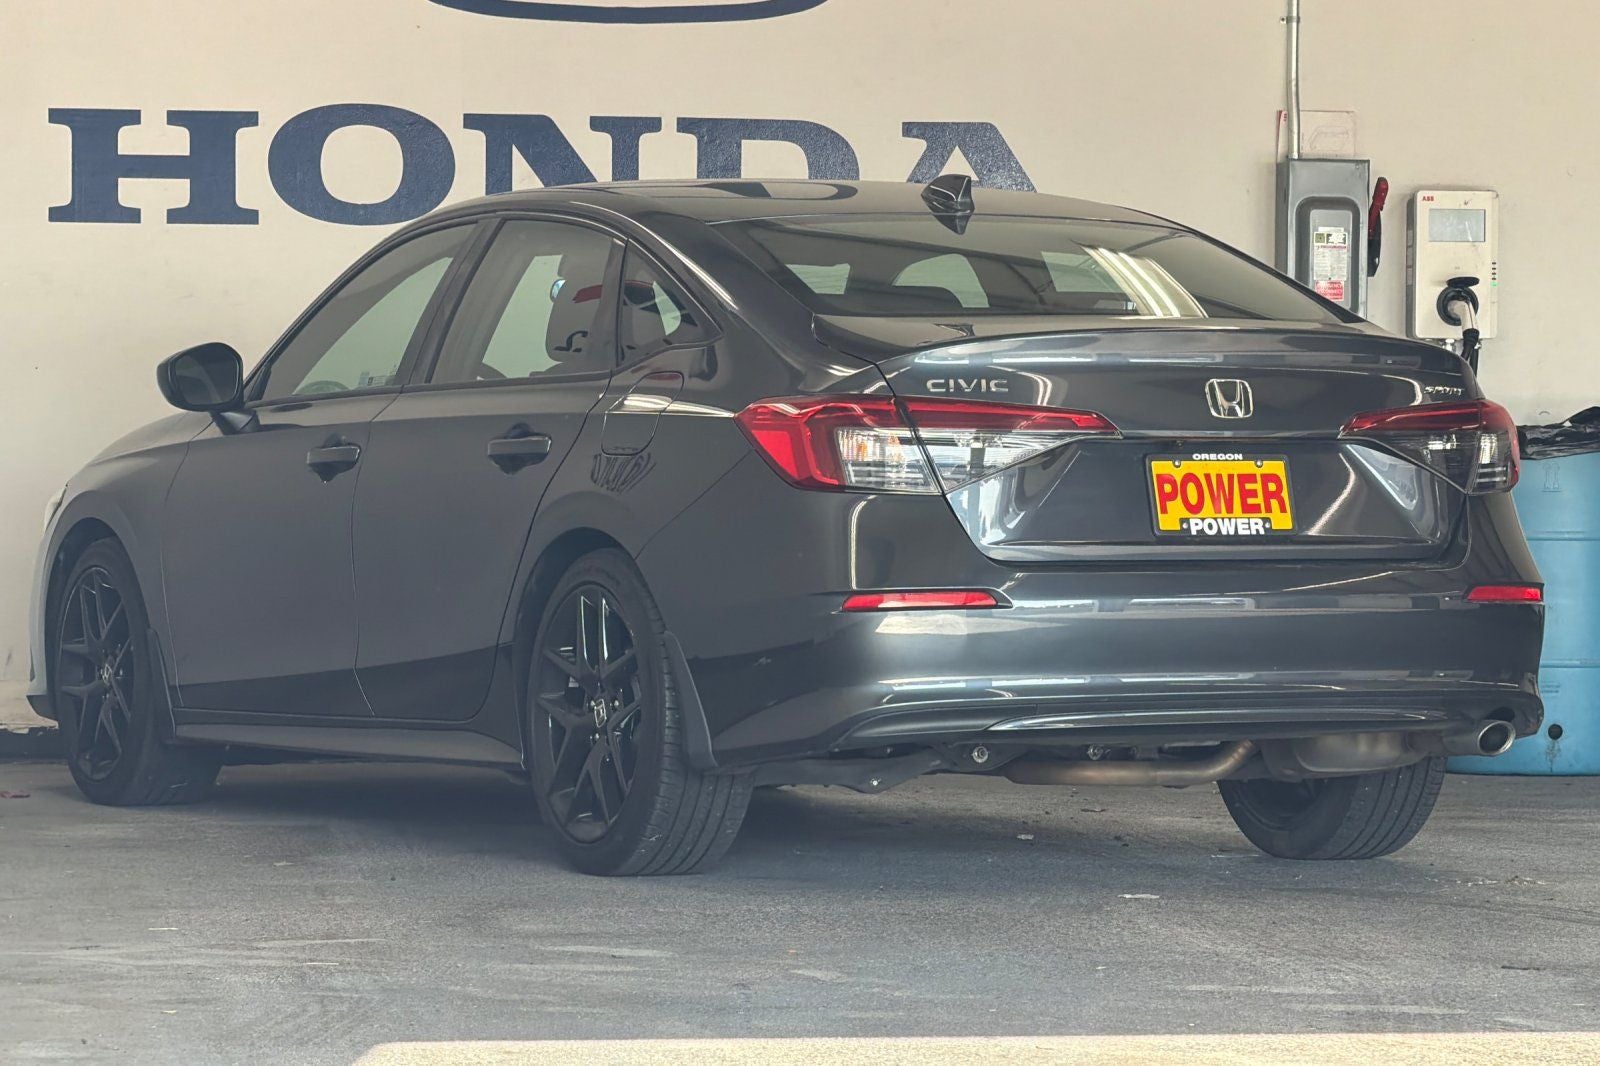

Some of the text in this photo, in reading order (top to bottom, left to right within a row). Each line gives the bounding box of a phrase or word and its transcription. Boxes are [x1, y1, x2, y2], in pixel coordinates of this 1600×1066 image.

[48, 103, 1037, 225] HONDA
[926, 378, 1009, 393] CIVIC
[1192, 453, 1244, 461] OREGON
[1155, 472, 1288, 515] POWER
[1189, 518, 1265, 536] POWER
